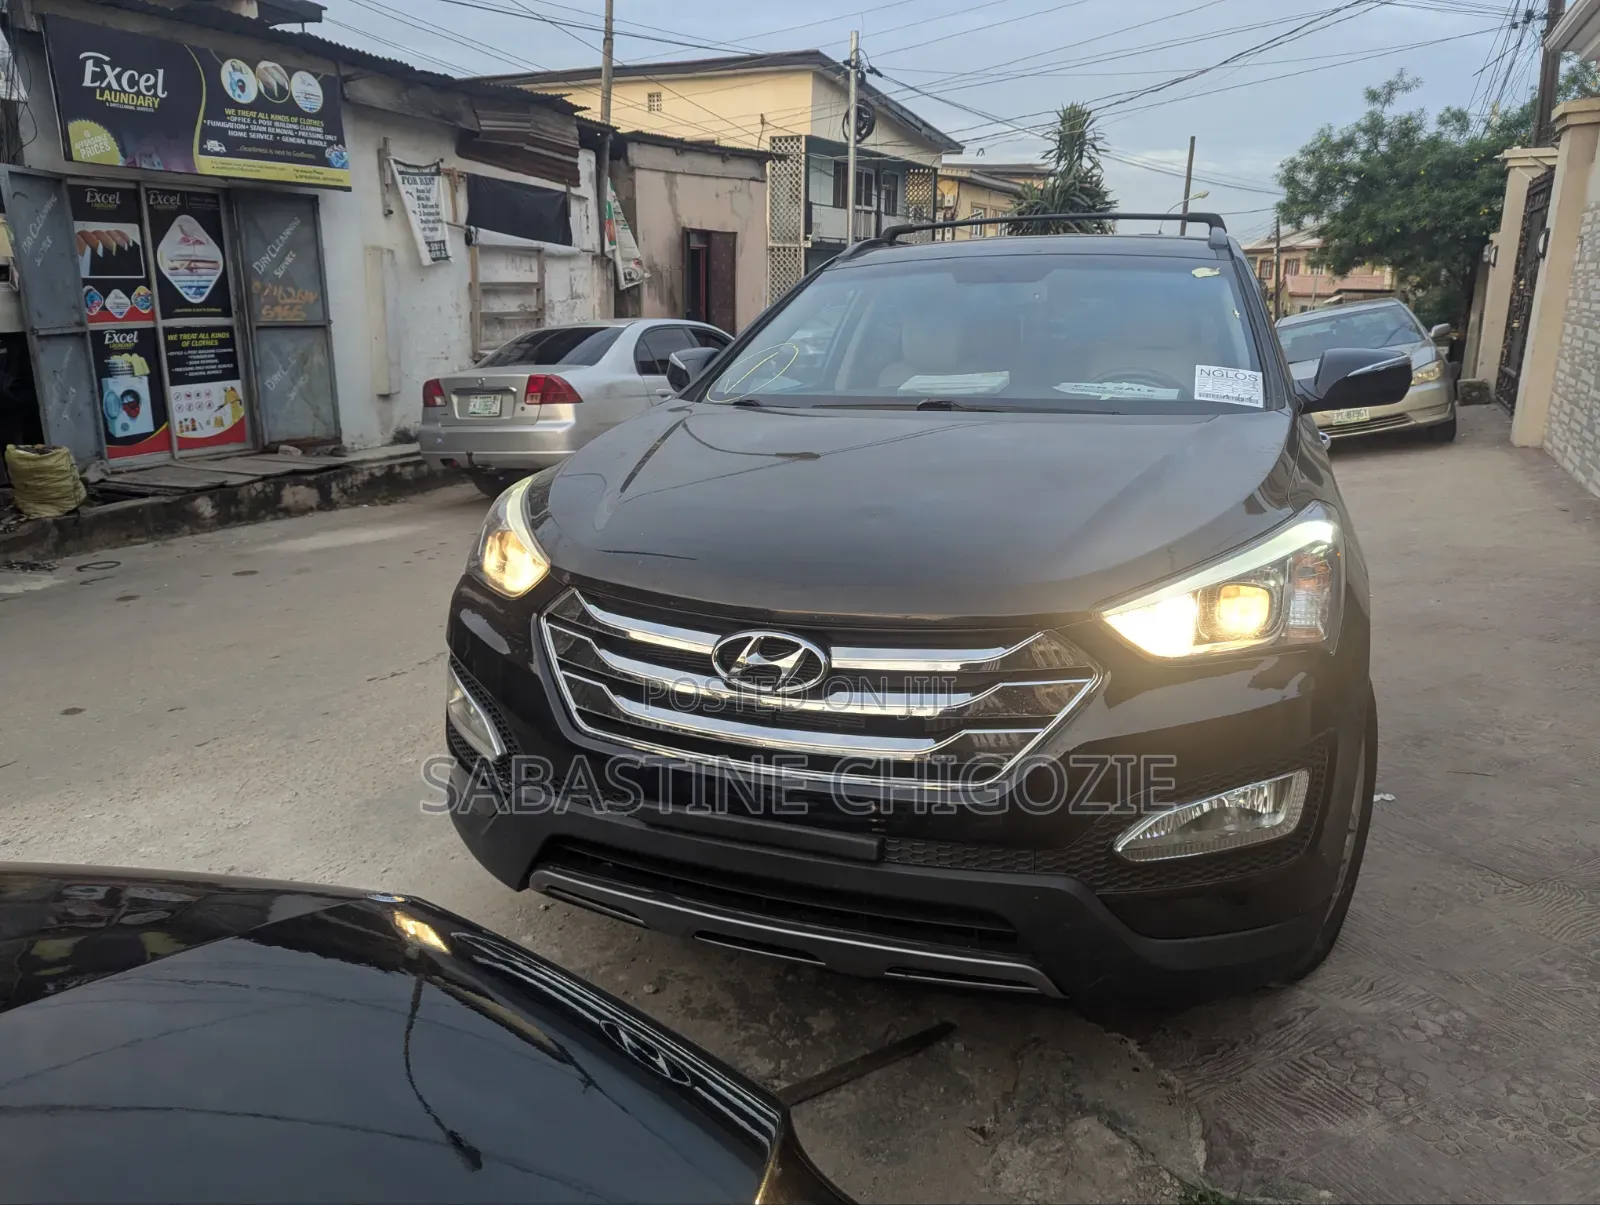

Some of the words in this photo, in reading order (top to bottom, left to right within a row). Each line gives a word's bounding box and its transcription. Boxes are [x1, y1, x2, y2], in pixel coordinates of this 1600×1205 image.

[79, 52, 167, 98] Excel
[96, 88, 160, 108] LAUNDARY
[224, 108, 236, 116] WE
[237, 109, 257, 118] TREAT
[258, 112, 270, 120] ALL
[270, 113, 290, 122] KINDS
[299, 117, 324, 127] CLOTHES
[229, 115, 251, 124] OFFICE
[273, 121, 299, 130] BUILDING
[207, 120, 246, 130] FUMIGATION
[250, 124, 267, 132] STAIN
[267, 127, 295, 136] REMOVAL
[298, 131, 324, 140] PRESSING
[324, 134, 337, 142] ONLY
[228, 130, 248, 138] HOME
[249, 131, 274, 141] SERVICE
[281, 135, 307, 145] GENERAL
[307, 139, 328, 148] BUNDLE
[80, 140, 111, 160] PRICES
[401, 176, 419, 185] FOR
[419, 177, 435, 185] RENT
[85, 188, 121, 205] Excel
[148, 190, 181, 205] Excel
[103, 330, 139, 345] Excel
[191, 339, 219, 347] CLOTHES
[1200, 368, 1258, 382] NGLOS
